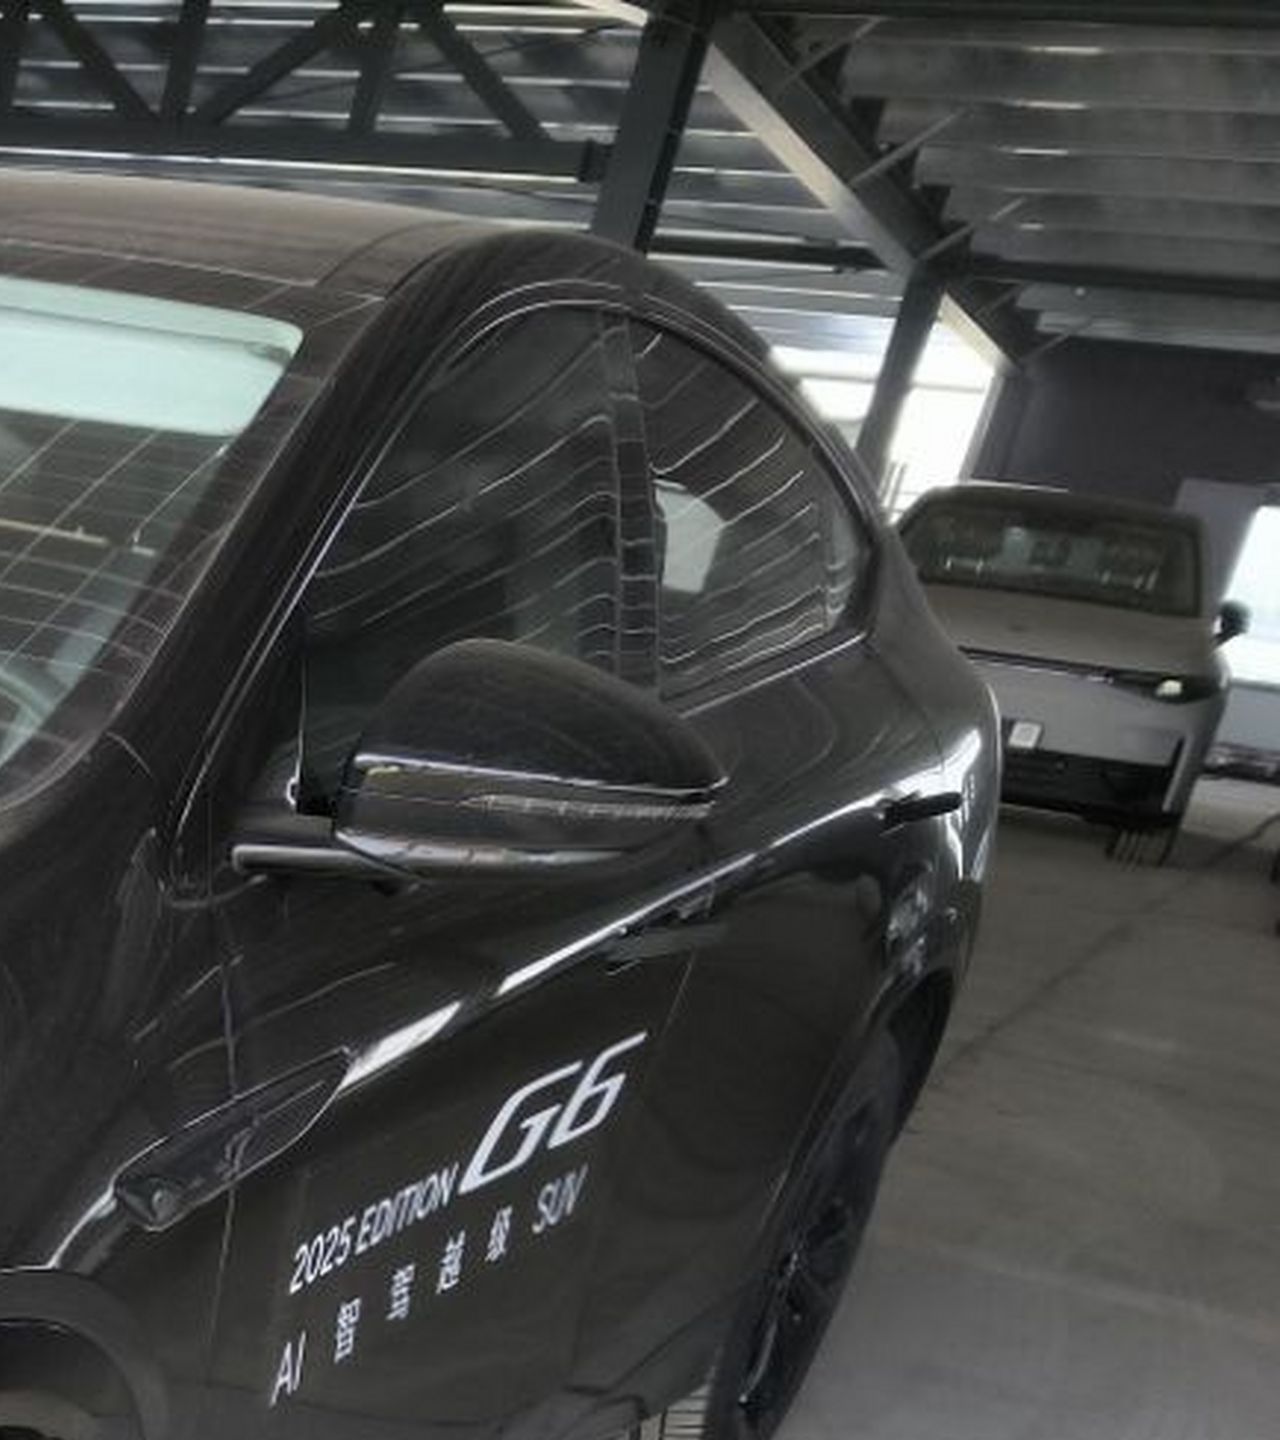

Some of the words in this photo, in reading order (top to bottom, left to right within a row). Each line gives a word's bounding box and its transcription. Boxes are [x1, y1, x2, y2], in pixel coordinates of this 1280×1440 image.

[269, 1331, 307, 1408] AI
[531, 1163, 589, 1234] SUV
[289, 1216, 357, 1295] 2025
[354, 1161, 460, 1255] EDITION
[458, 1031, 647, 1195] G6
